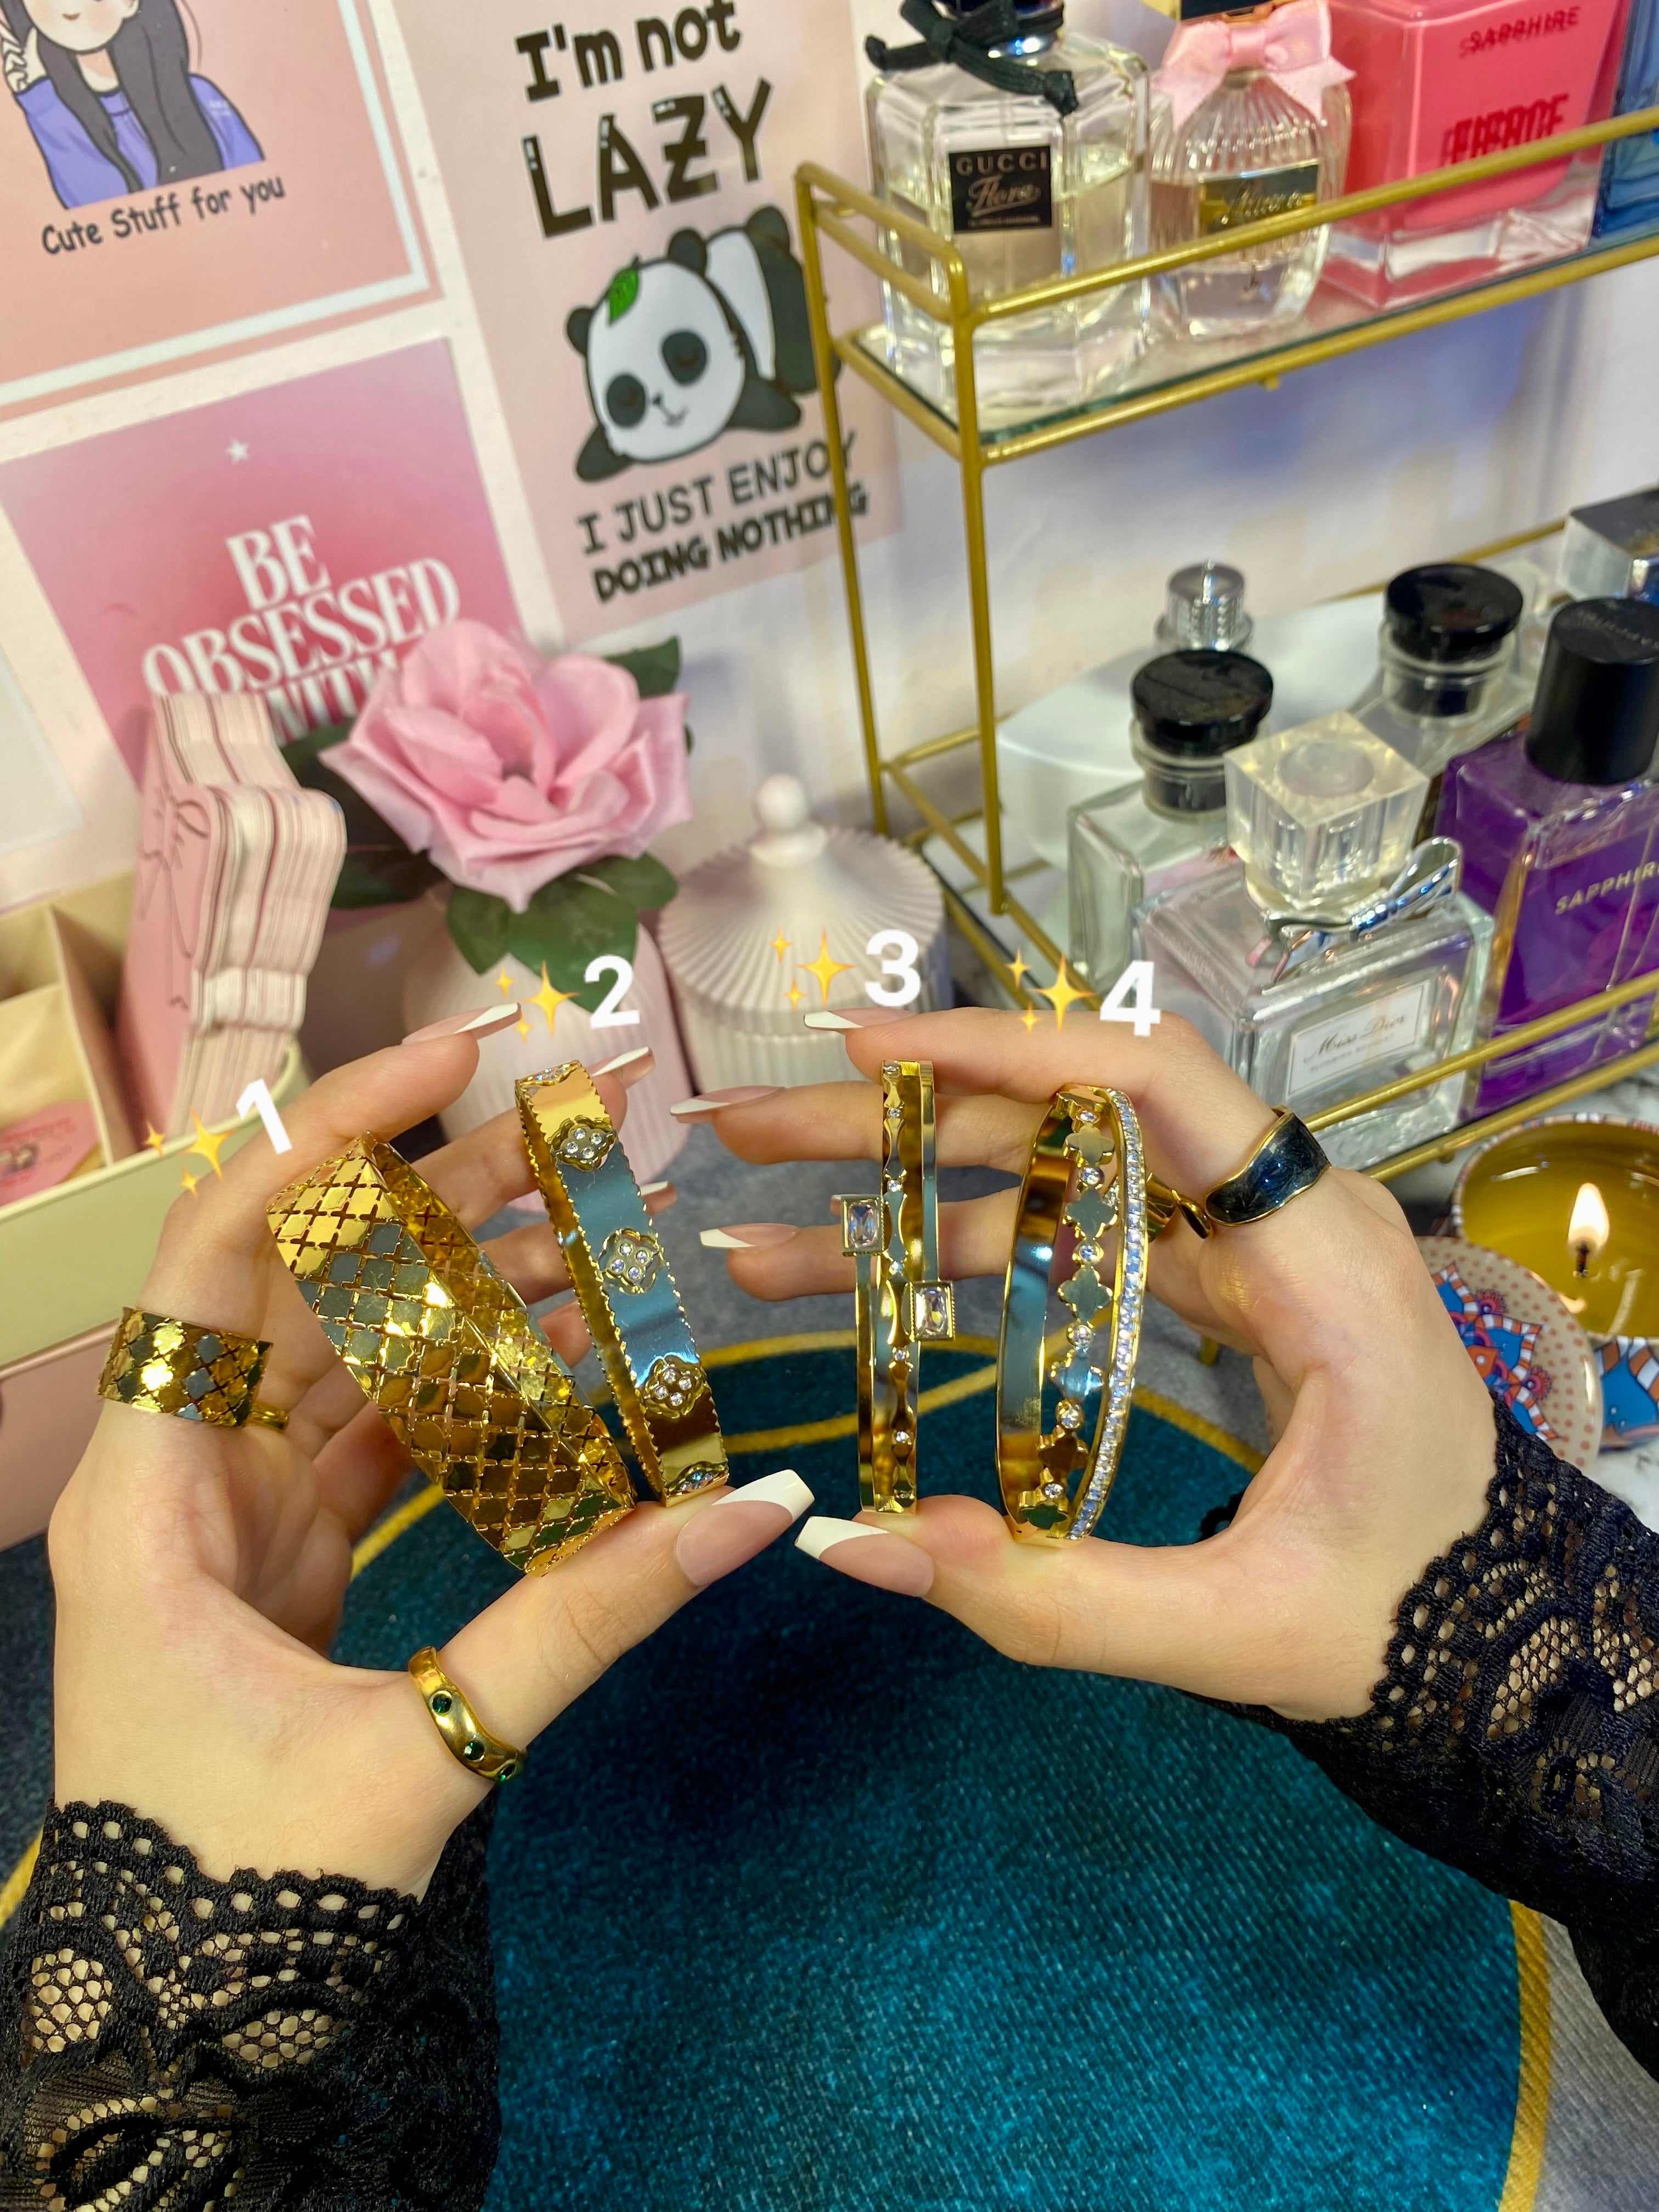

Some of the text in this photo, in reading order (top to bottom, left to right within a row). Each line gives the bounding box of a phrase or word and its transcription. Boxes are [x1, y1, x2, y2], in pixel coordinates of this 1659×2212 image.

[515, 1, 742, 103] I'm not
[1462, 5, 1581, 56] SAPPHIRE
[522, 77, 774, 240] LAZY
[955, 151, 1047, 176] GUCCI
[42, 176, 286, 256] Cute Stuff for you
[577, 512, 605, 555] I
[614, 474, 716, 543] JUST
[225, 514, 332, 612] BE
[592, 538, 709, 604] DOING
[142, 557, 461, 697] OBSESSED
[1555, 861, 1659, 915] SAPPHIR
